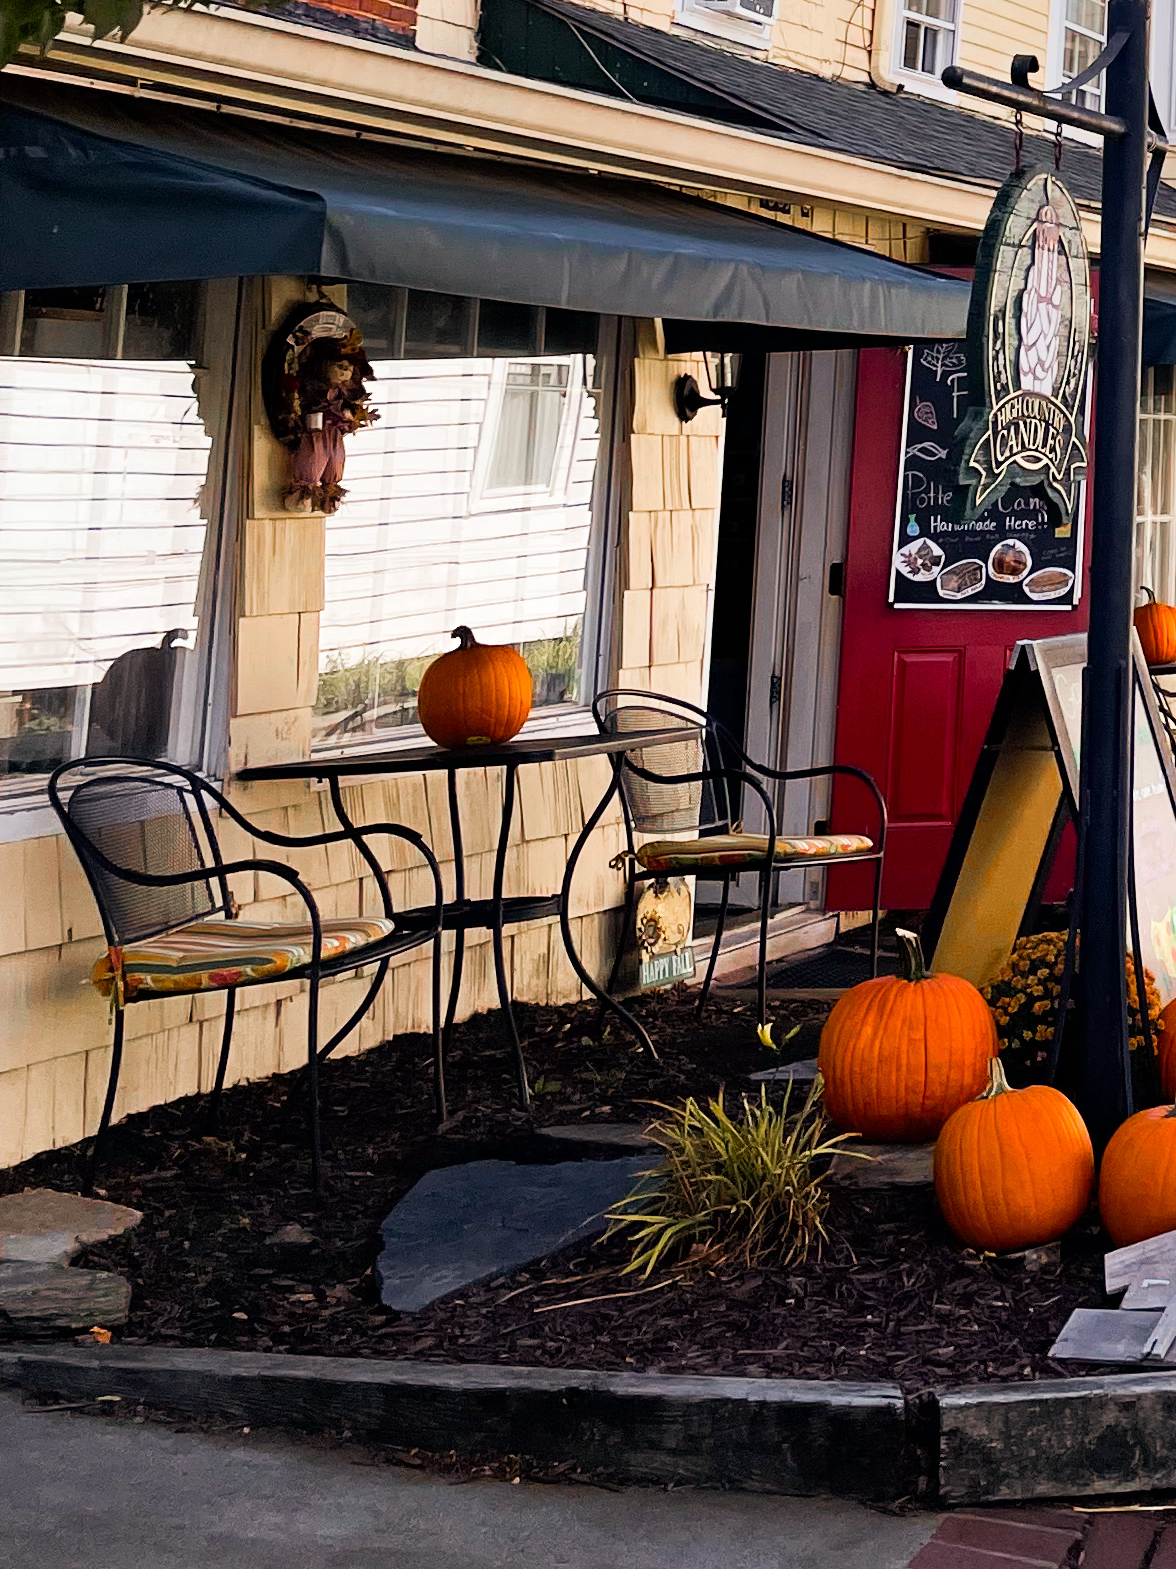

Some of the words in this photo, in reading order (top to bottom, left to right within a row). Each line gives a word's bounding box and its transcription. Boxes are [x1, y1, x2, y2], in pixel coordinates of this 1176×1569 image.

[998, 396, 1023, 430] HIGH
[1023, 396, 1064, 433] COUNTRY
[996, 418, 1064, 467] CANDLES
[904, 471, 953, 510] Potte
[642, 957, 669, 984] HAPPY
[672, 951, 694, 977] FALL
